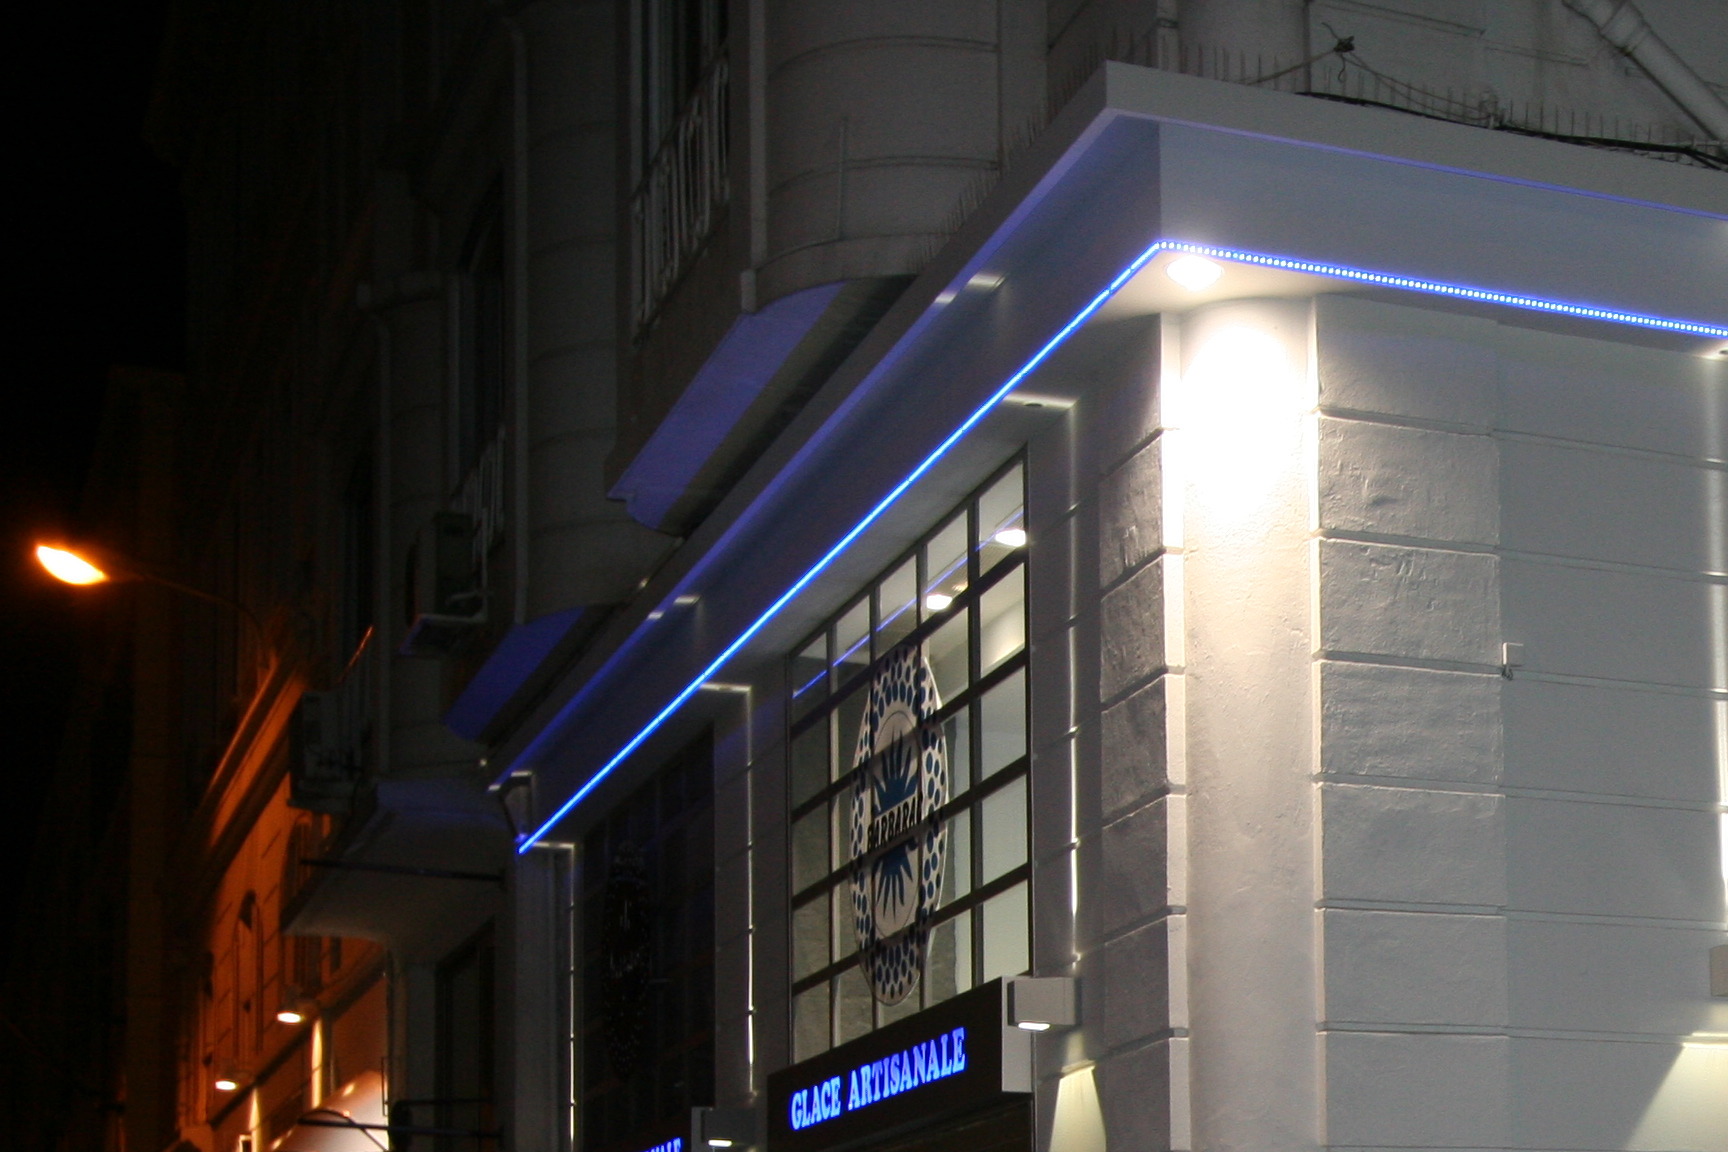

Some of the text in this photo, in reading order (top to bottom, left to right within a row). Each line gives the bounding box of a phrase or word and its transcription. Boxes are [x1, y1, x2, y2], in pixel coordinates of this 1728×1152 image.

[867, 791, 923, 854] BARBARA
[791, 1026, 967, 1131] GLACE ARTISANALE
